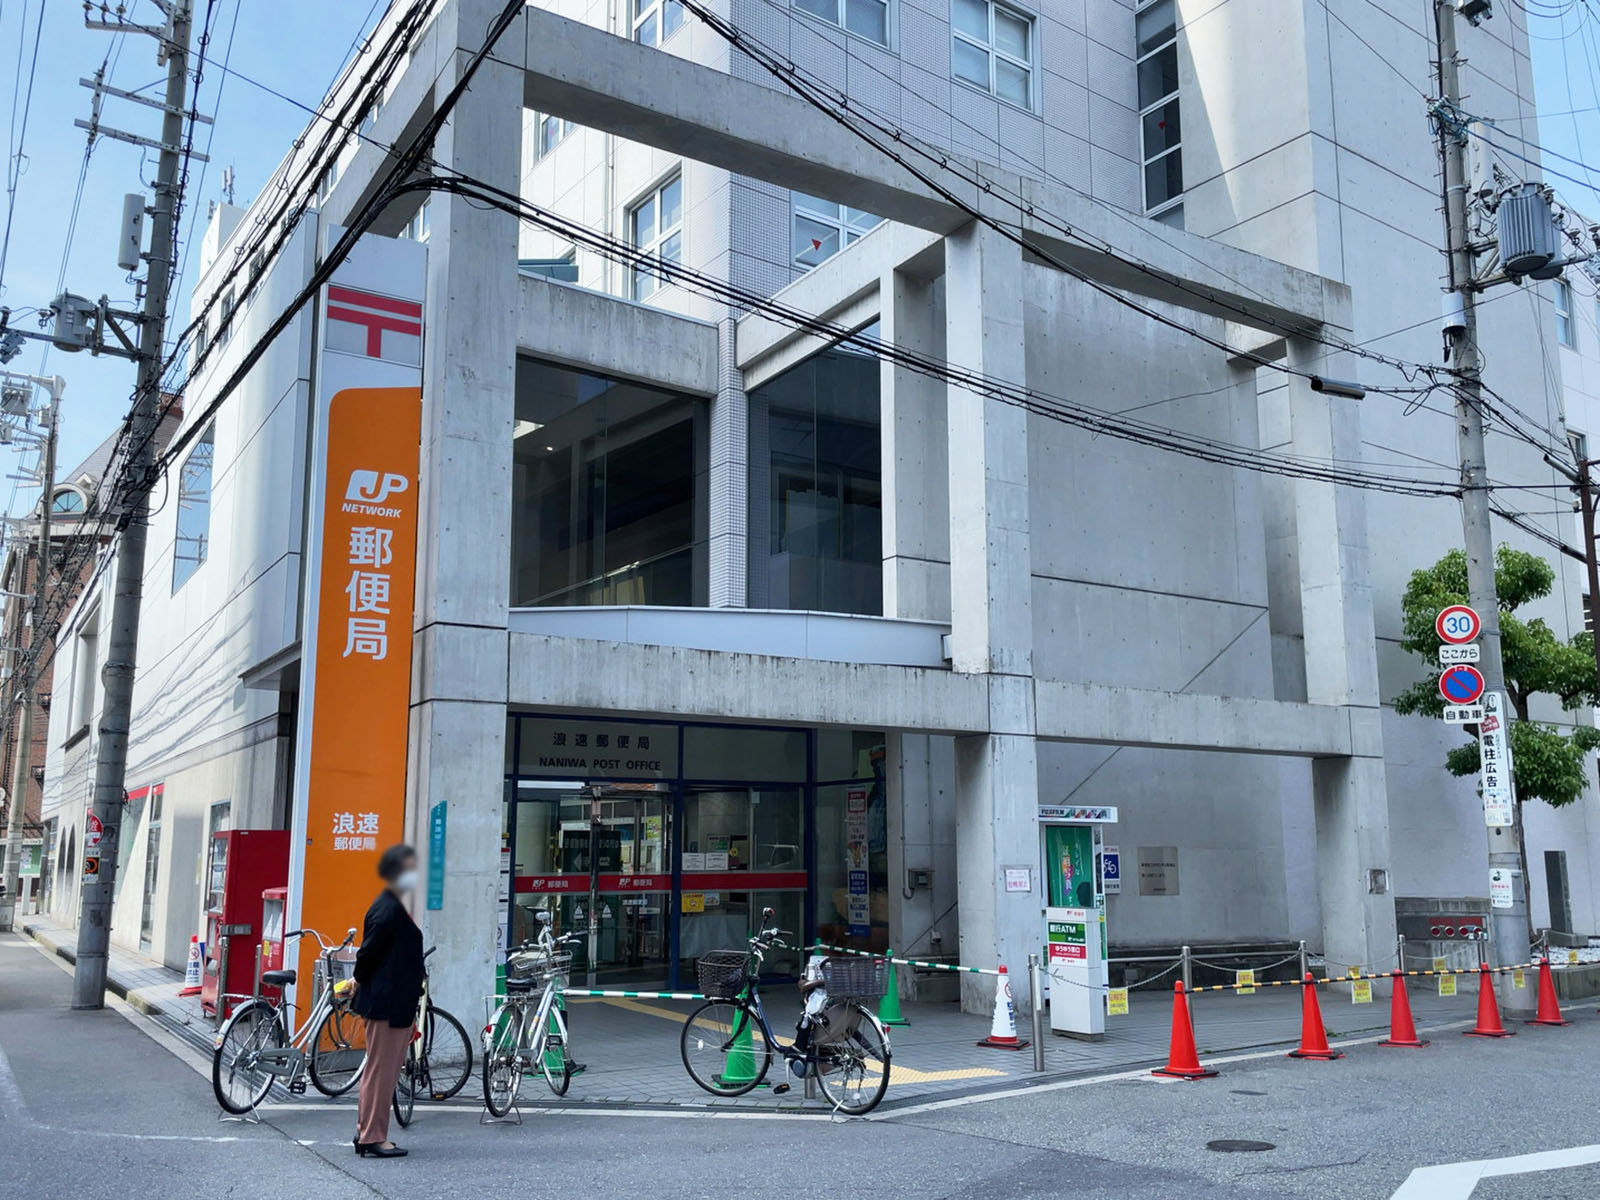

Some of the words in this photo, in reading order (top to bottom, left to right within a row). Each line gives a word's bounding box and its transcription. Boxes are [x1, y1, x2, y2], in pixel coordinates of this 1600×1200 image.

[345, 469, 408, 503] JP
[341, 503, 402, 518] NETWORK
[342, 526, 393, 660] 郵便局
[1446, 616, 1470, 633] 30
[1441, 649, 1478, 659] ここから
[1446, 709, 1482, 720] 自動車
[552, 732, 650, 750] 浪速郵便局
[539, 757, 587, 768] NANIWA
[593, 759, 621, 769] POST
[626, 760, 661, 771] OFFICE
[1483, 735, 1497, 788] 電柱広告
[332, 812, 379, 834] 浪速
[333, 836, 377, 851] 郵便局
